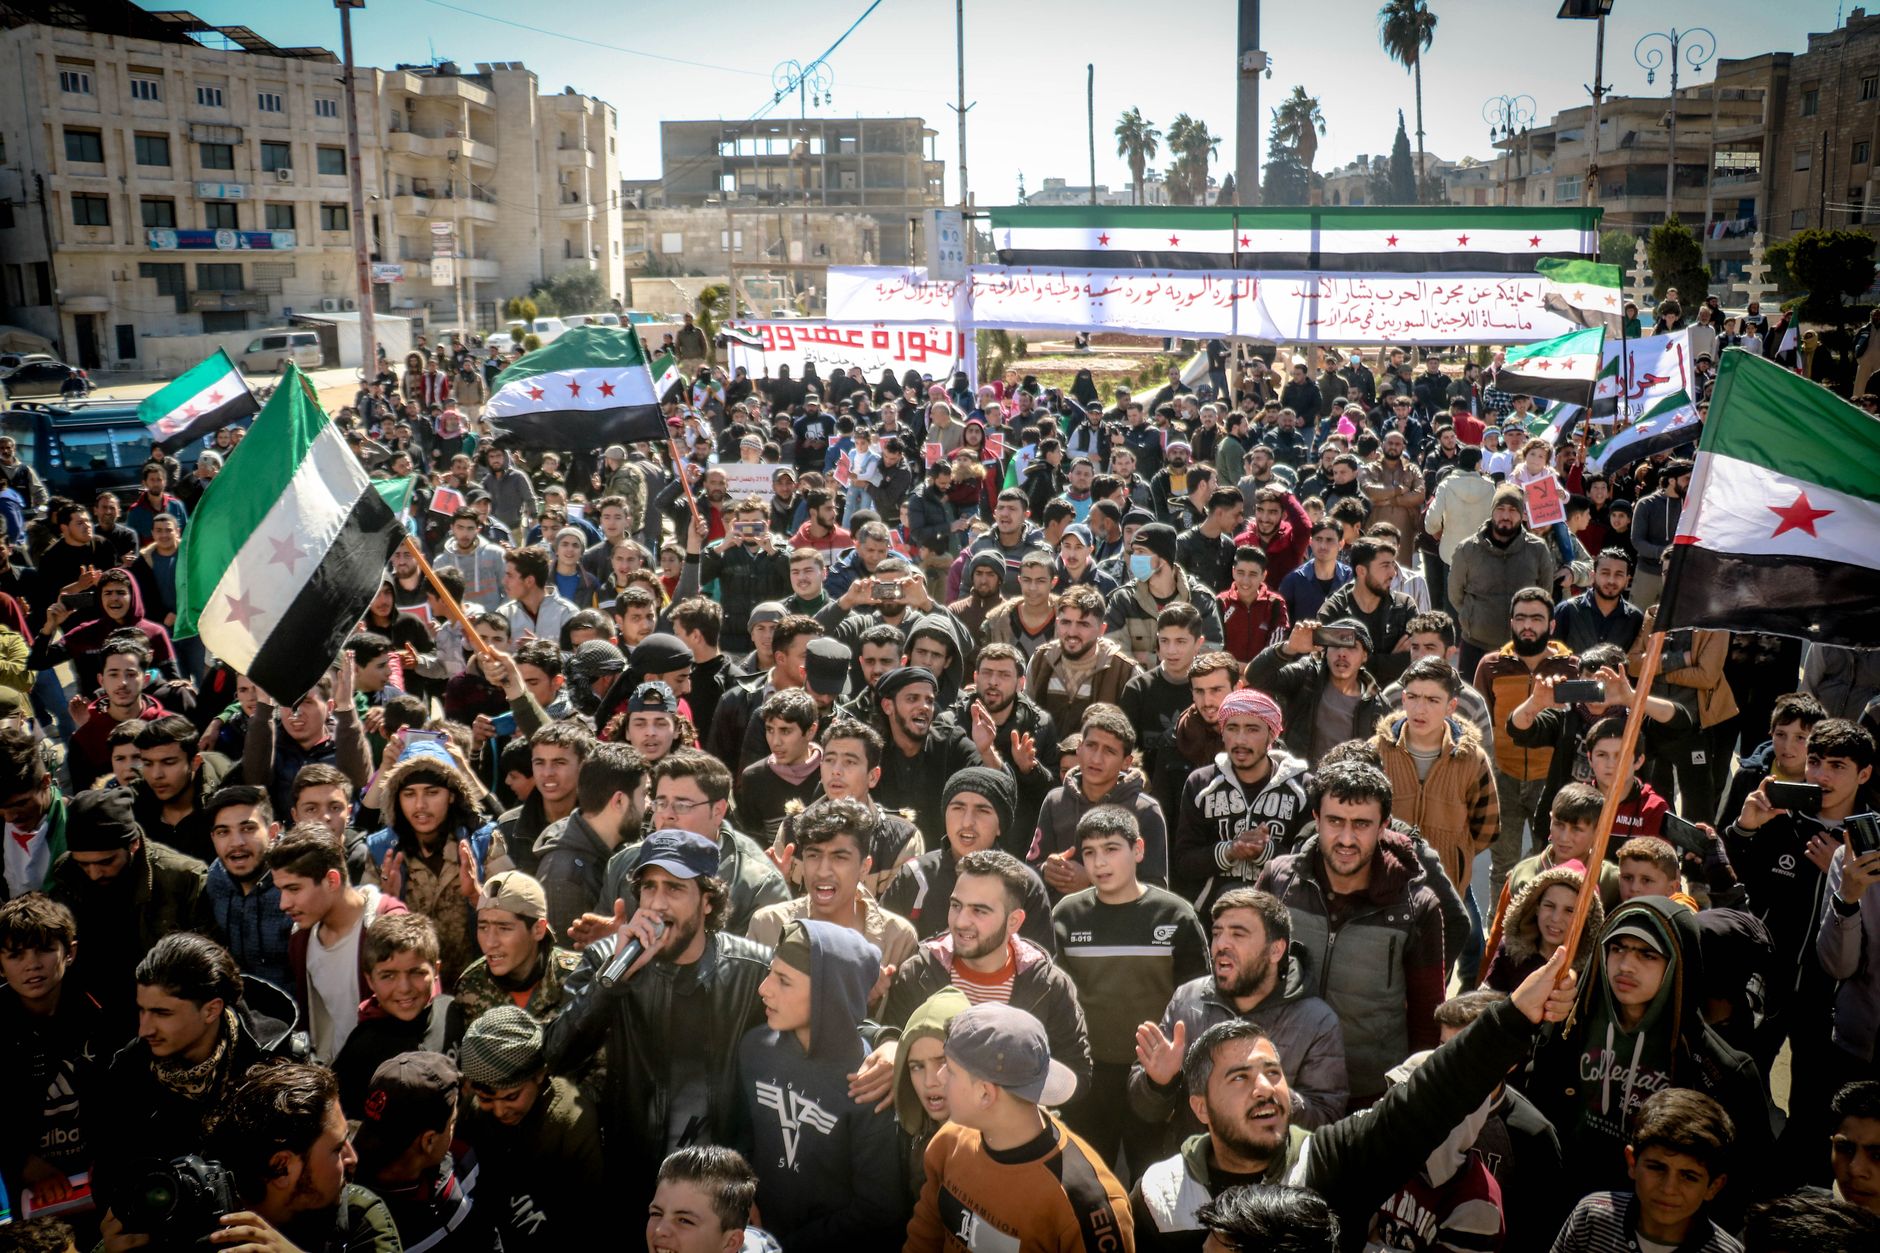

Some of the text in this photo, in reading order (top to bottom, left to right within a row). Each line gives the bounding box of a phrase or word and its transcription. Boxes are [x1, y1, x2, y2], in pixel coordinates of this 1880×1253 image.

[1045, 271, 1080, 303] وطنية
[1083, 273, 1122, 306] شعبية
[1125, 273, 1161, 304] ثورة
[1165, 273, 1212, 311] السورية
[1212, 275, 1260, 308] الثورة
[1342, 277, 1374, 306] بشار
[1375, 280, 1427, 306] الحرب
[1431, 283, 1463, 308] مجرم
[1468, 283, 1492, 305] عن
[1360, 308, 1375, 335] هي
[1376, 309, 1430, 340] السوريين
[871, 322, 965, 362] الثورة
[1534, 481, 1548, 499] لا
[1205, 788, 1295, 820] FASION
